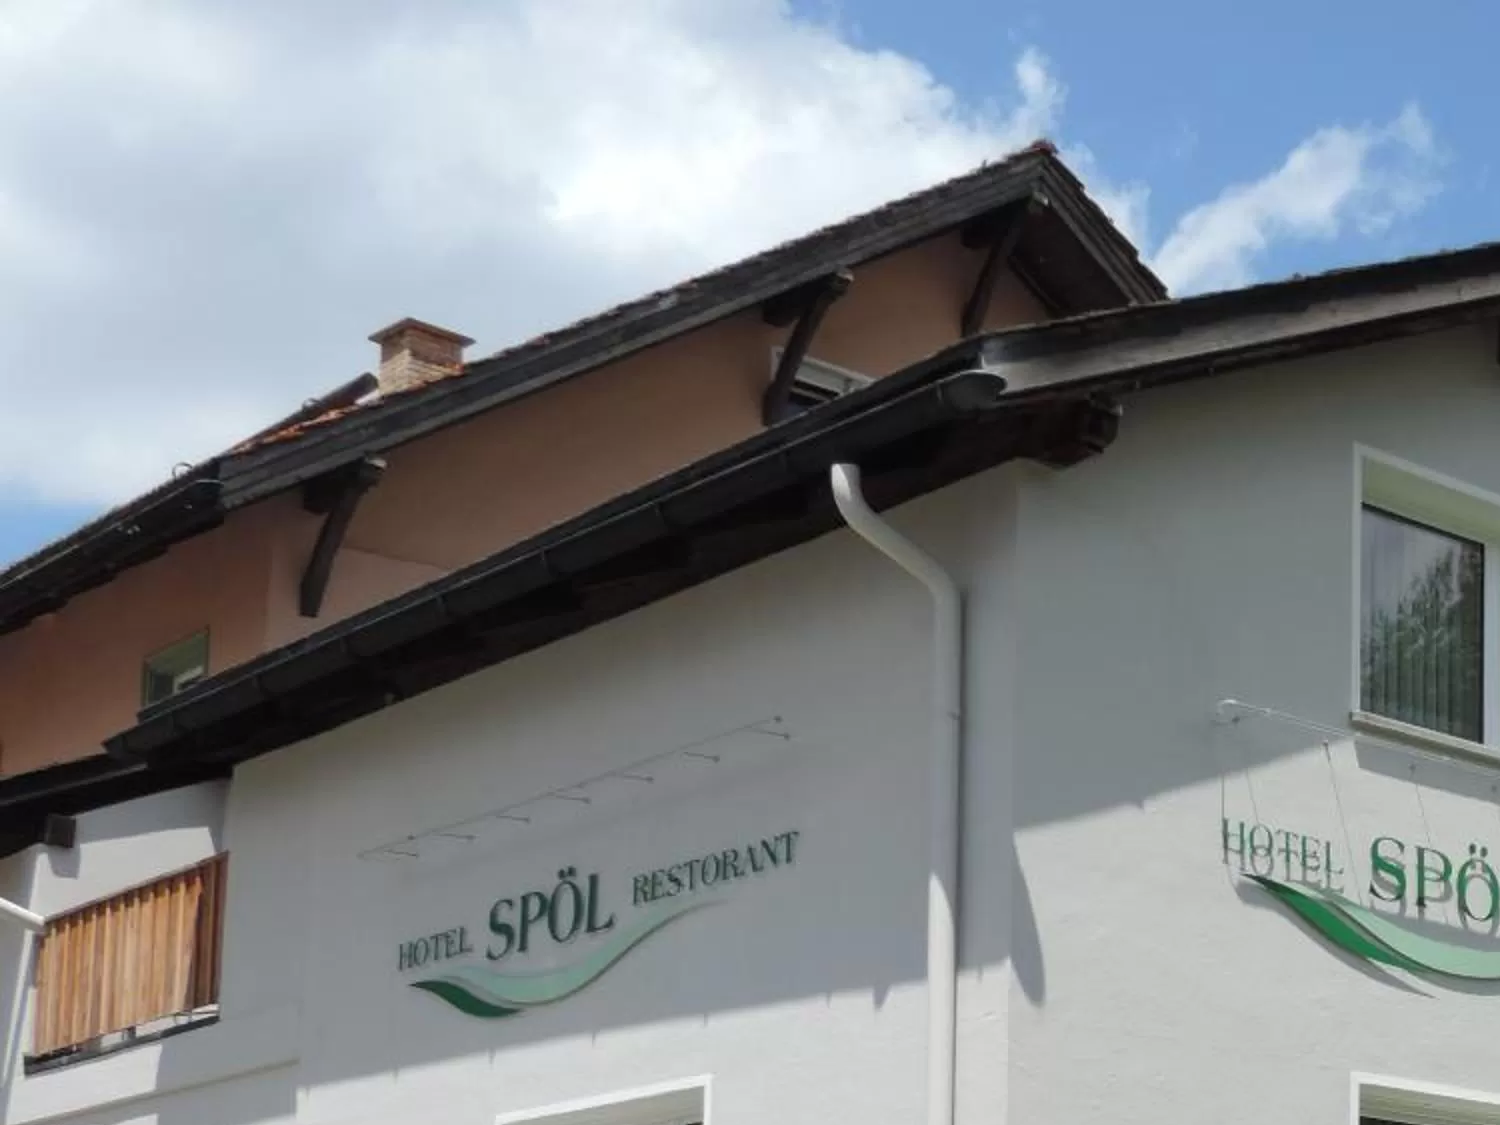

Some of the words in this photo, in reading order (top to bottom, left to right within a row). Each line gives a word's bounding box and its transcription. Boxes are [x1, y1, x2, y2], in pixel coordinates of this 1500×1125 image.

[1221, 817, 1345, 876] HOTEL
[397, 926, 473, 972] HOTEL
[486, 865, 615, 961] SPÖL
[631, 830, 800, 906] RESTORANT
